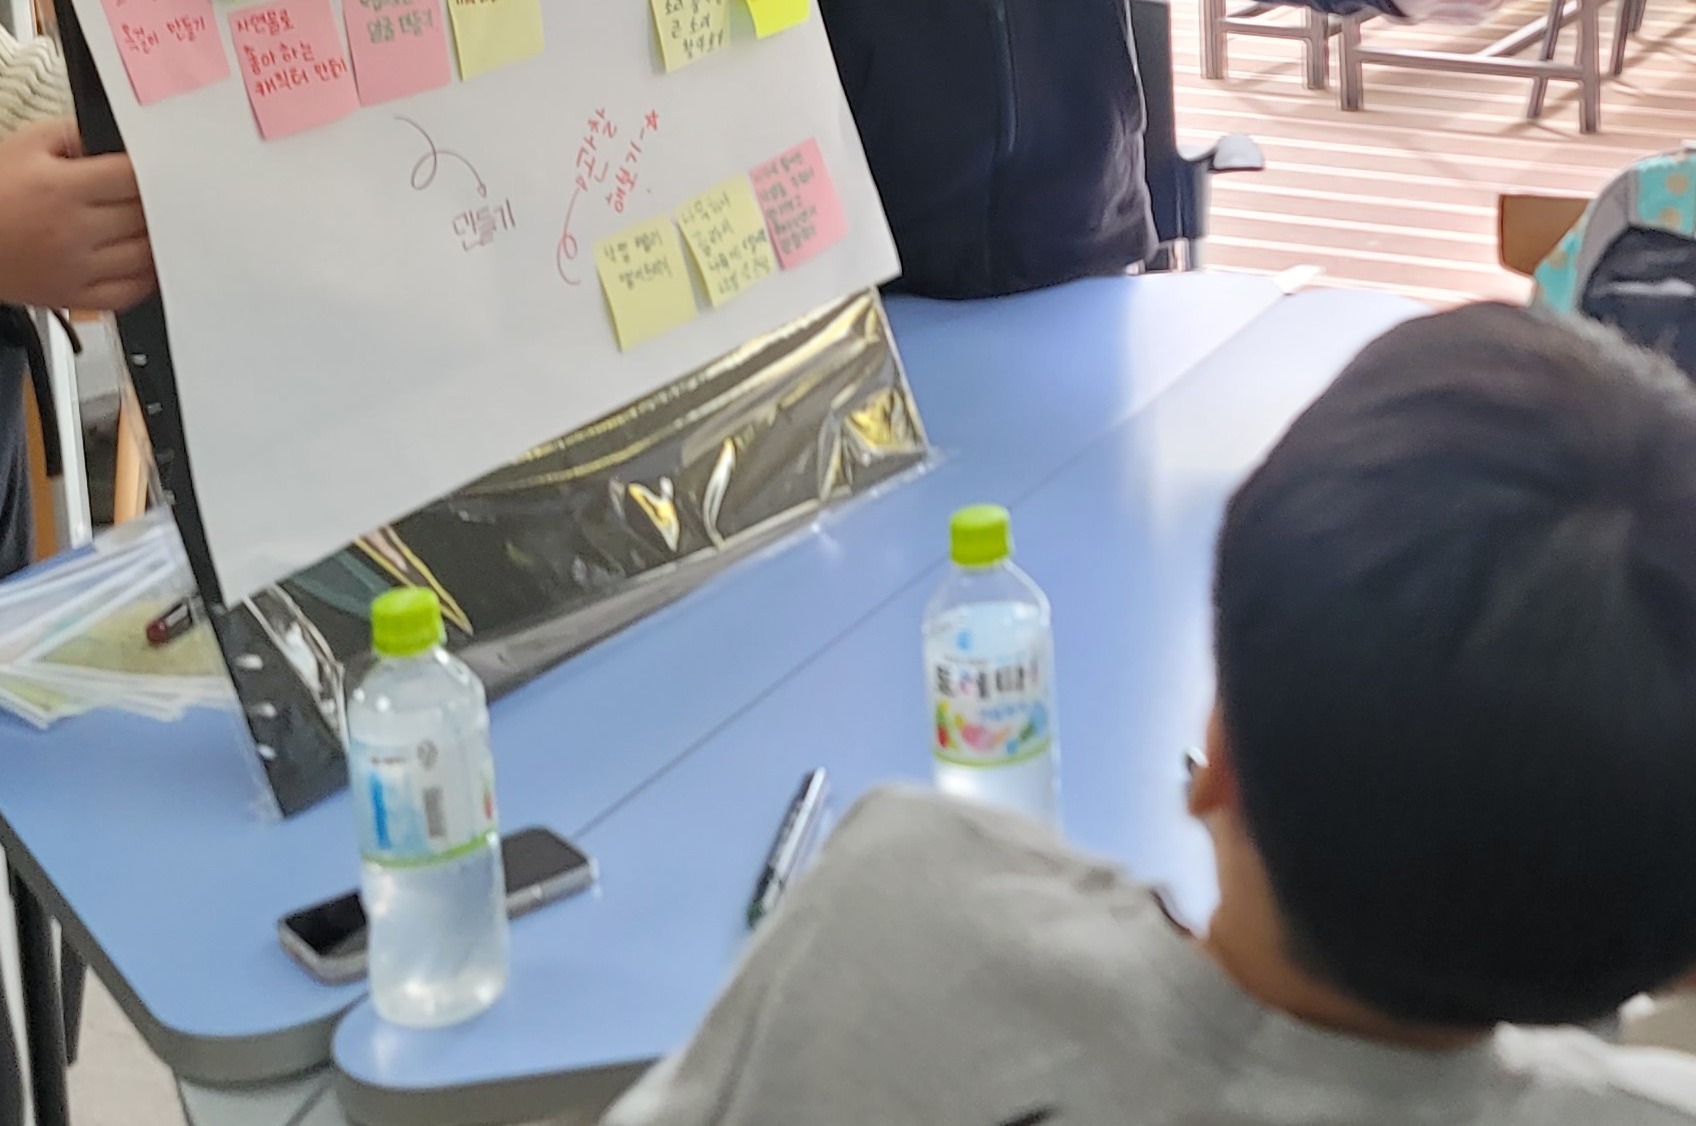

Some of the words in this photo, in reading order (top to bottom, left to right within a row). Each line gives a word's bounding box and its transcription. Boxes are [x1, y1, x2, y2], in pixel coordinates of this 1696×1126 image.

[165, 14, 206, 42] 만들기
[313, 57, 349, 82] 만들기
[452, 197, 517, 253] 만들기
